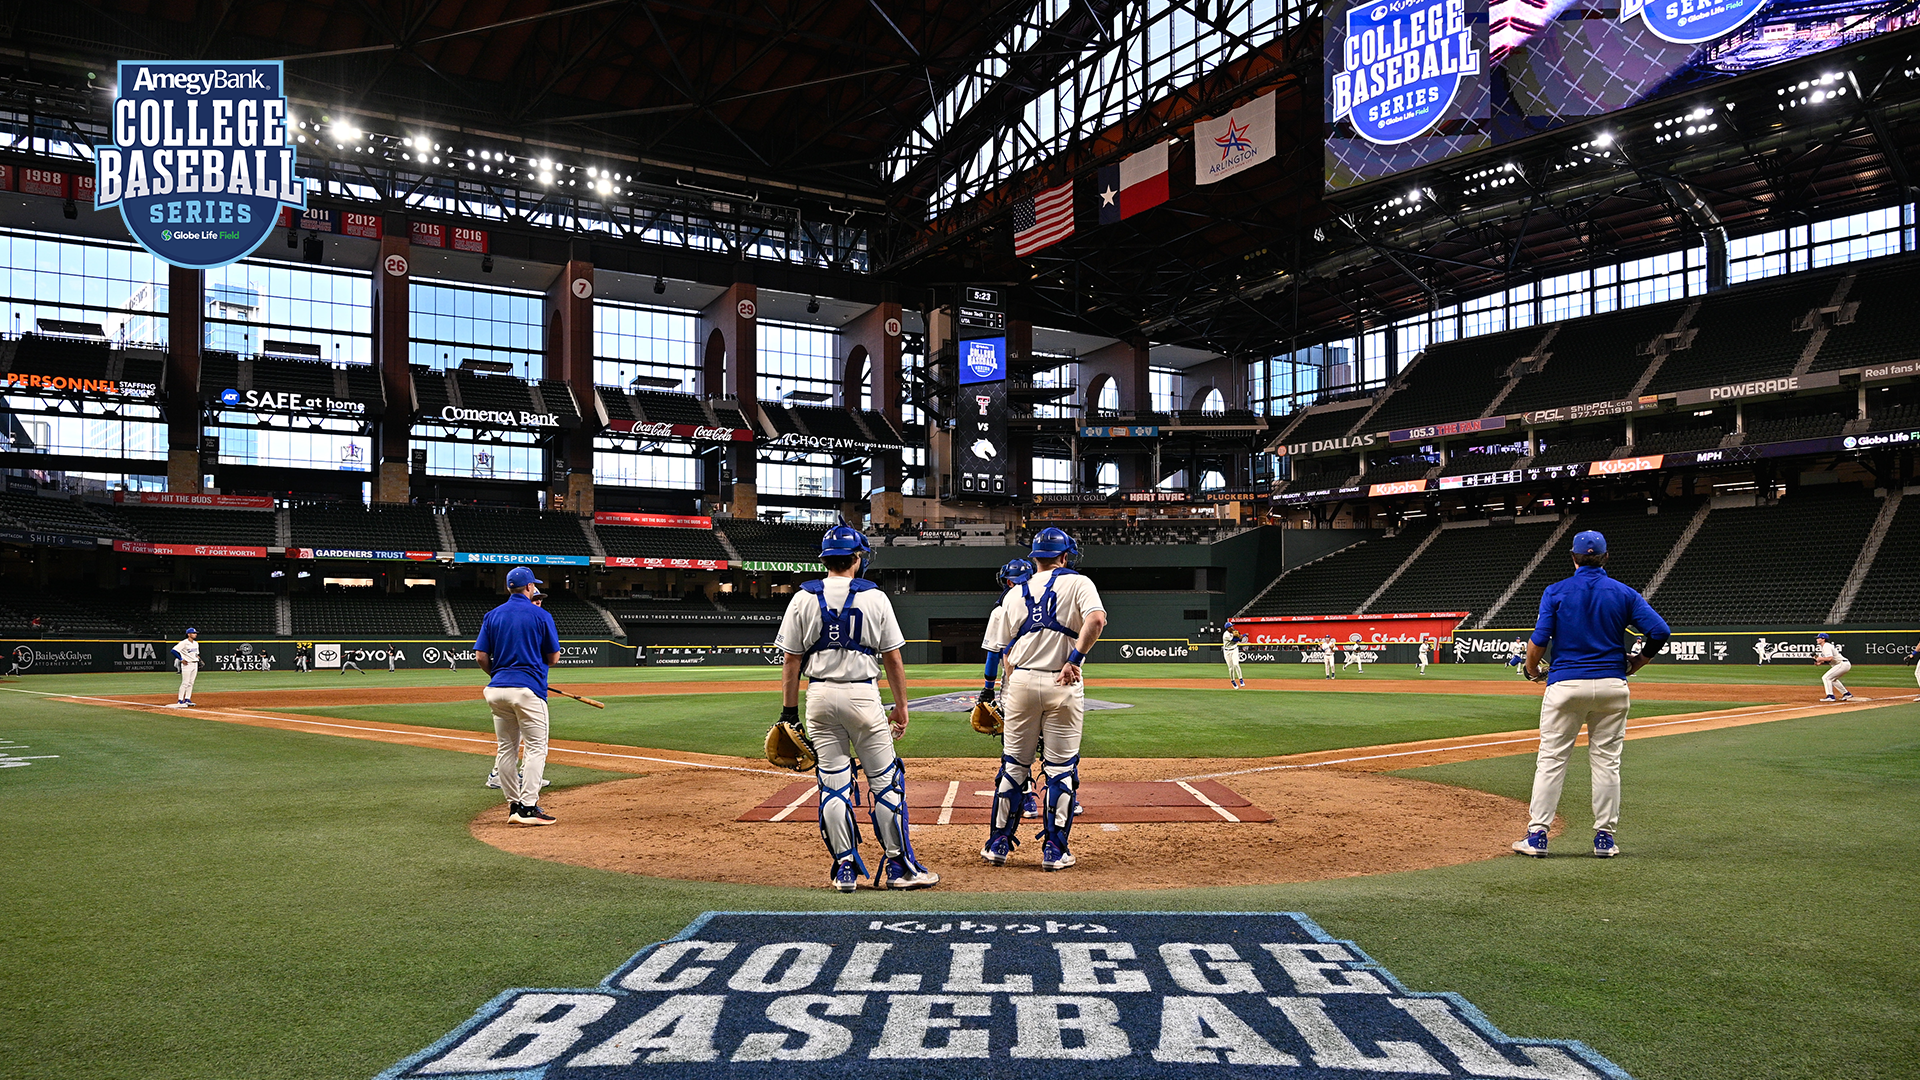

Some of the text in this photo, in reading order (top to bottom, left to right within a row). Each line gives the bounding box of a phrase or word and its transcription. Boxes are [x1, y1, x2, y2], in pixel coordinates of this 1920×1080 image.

[1687, 1, 1744, 23] Globe Life Field
[1346, 0, 1463, 71] COLLEGE
[1336, 30, 1477, 117] BASEBALL
[1368, 86, 1440, 122] SERIES
[1385, 106, 1430, 126] Globe Life Field
[1209, 147, 1258, 174] ARLINGTON
[25, 169, 62, 185] 1998
[302, 208, 330, 220] 2011
[347, 213, 376, 227] 2012
[412, 222, 440, 236] 2015
[455, 228, 482, 241] 2016
[386, 258, 406, 272] 26
[578, 282, 587, 294] 7
[974, 291, 991, 301] 5:23
[738, 303, 754, 315] 29
[887, 321, 898, 333] 10
[1864, 364, 1914, 378] Real fans
[7, 372, 119, 393] PERSONNEL
[119, 381, 157, 391] STAFFING
[1709, 377, 1799, 401] POWERADE
[223, 393, 238, 401] ADT
[246, 390, 366, 412] SAFE at home
[1570, 399, 1633, 413] ShipPGL.com
[1570, 405, 1633, 419] 877.701.1919
[519, 411, 560, 427] Bank
[1534, 408, 1565, 422] PGL
[977, 421, 989, 432] VS
[1408, 420, 1482, 439] 105.3 THE FAN
[790, 433, 854, 449] CHOCTAW
[1287, 433, 1375, 456] UT DALLAS
[1857, 432, 1910, 446] Globe Life
[1696, 450, 1723, 462] MPH
[1599, 459, 1653, 473] Kubota
[1483, 475, 1492, 484] H
[1550, 471, 1557, 479] 0
[1569, 469, 1576, 477] 0
[965, 479, 1001, 490] 0 0 0
[1375, 482, 1418, 494] Kubota
[161, 494, 175, 502] HIT
[175, 495, 191, 503] THE
[191, 495, 212, 504] BUDS
[1043, 493, 1107, 502] PRIORITY GOLD
[1129, 493, 1185, 502] HART HVAC
[1206, 493, 1255, 501] PLUCKERS
[30, 533, 57, 544] SHIFT
[132, 545, 147, 553] FORT
[147, 546, 173, 554] WORTH
[315, 549, 405, 559] GARDENERS TRUST
[481, 554, 540, 563] NETSPEND
[643, 557, 664, 565] DEX
[753, 561, 793, 572] LUXOR
[123, 643, 157, 660] UTA
[1135, 645, 1189, 657] Globe Life
[1670, 641, 1706, 655] BITE
[35, 650, 92, 662] Bailey&Galyen
[1247, 653, 1275, 662] Kubota
[1675, 653, 1700, 661] PIZZA
[869, 920, 1117, 935] Kubota
[617, 939, 1394, 995] COLLEGE
[409, 992, 1592, 1079] BASEBALL
